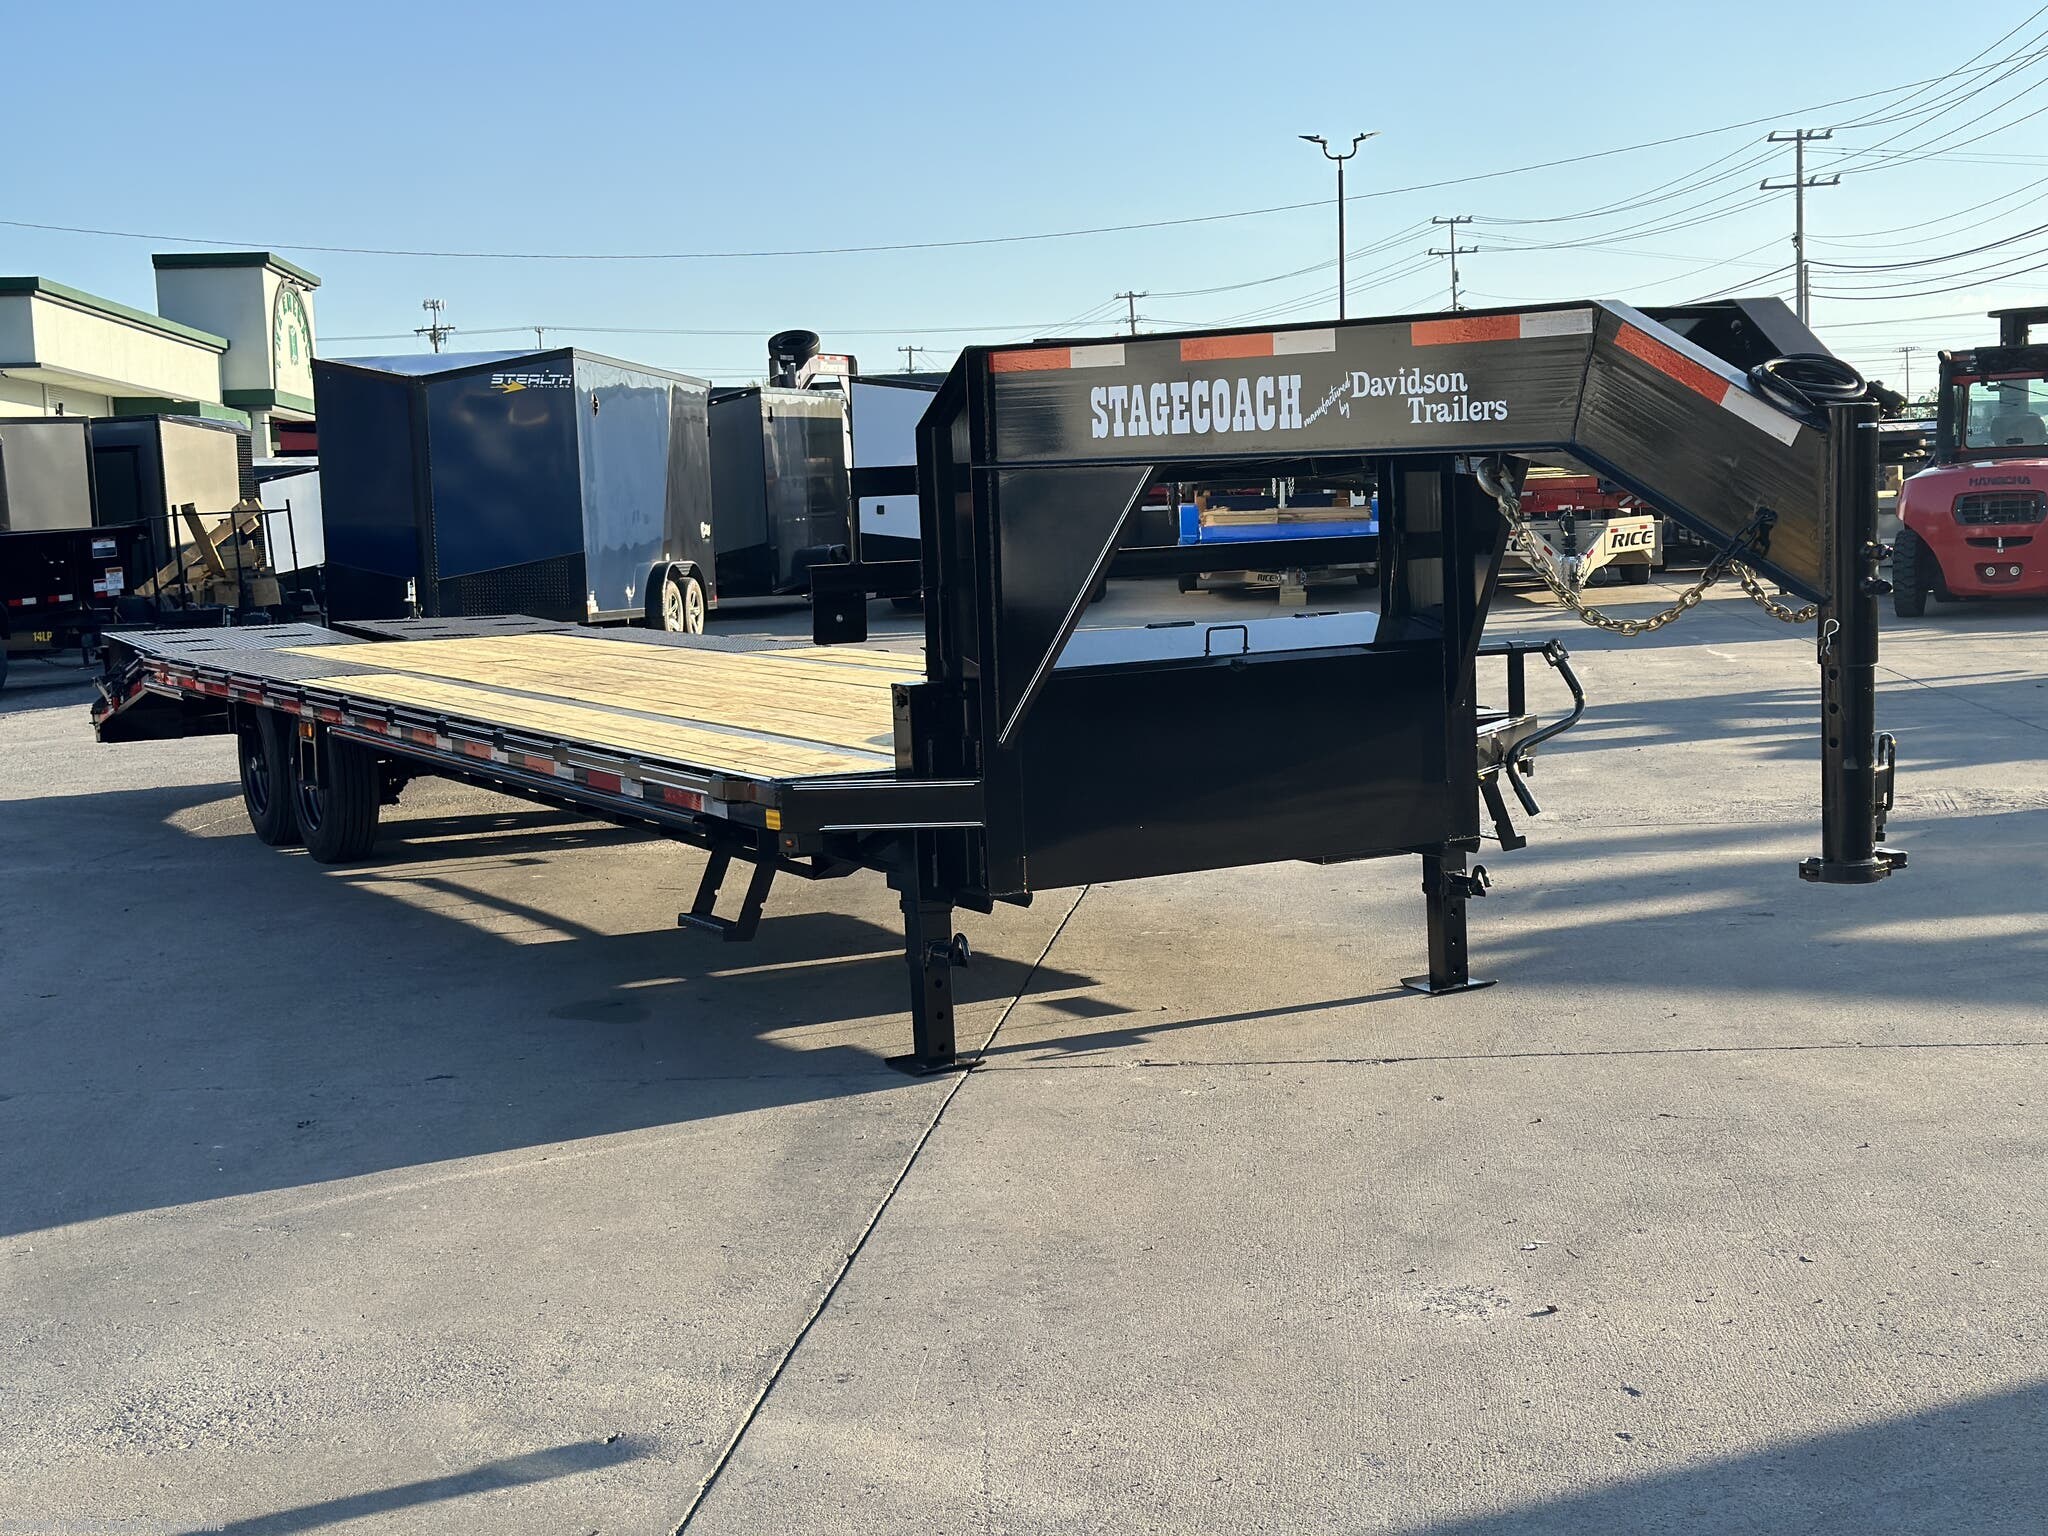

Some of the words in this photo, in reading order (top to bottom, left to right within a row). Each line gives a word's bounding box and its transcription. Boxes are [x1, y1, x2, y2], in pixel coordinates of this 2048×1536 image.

[491, 372, 572, 384] STEALTH
[1351, 367, 1468, 398] Davidson
[1090, 374, 1302, 439] STAGECOACH
[1303, 371, 1350, 428] manufactured
[1339, 399, 1350, 419] by
[1407, 394, 1508, 424] Trailers
[1611, 530, 1653, 548] RICE
[32, 631, 53, 642] 14LP
